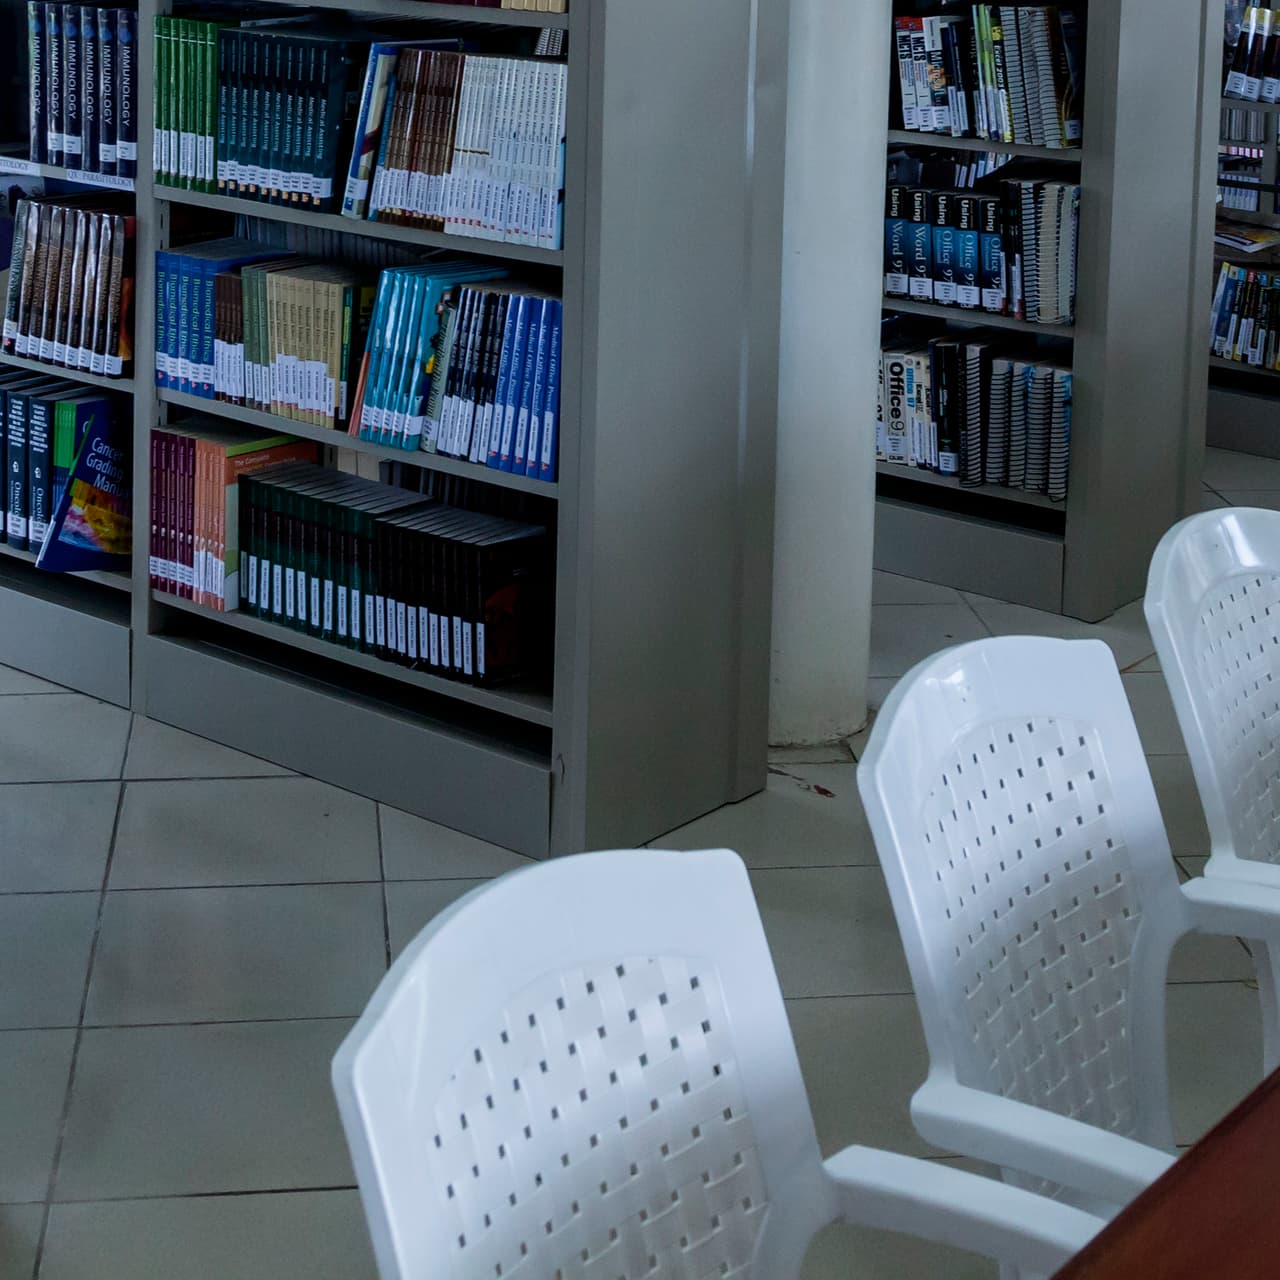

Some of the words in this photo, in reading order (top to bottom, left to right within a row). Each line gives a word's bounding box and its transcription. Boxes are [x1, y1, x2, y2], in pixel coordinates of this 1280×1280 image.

[898, 34, 912, 60] MCTS
[912, 36, 926, 62] MCTS
[33, 36, 41, 114] IMMUNOLOGY
[51, 38, 59, 117] IMMUNOLOGY
[68, 40, 77, 119] IMMUNOLOGY
[86, 42, 94, 121] IMMUNOLOGY
[103, 45, 112, 125] IMMUNOLOGY
[122, 46, 131, 126] IMMUNOLOGY
[891, 188, 900, 216] Using
[913, 193, 922, 221] Using
[937, 196, 947, 225] Using
[960, 200, 969, 229] Using
[986, 202, 996, 231] Using
[892, 222, 904, 255] Word
[915, 226, 927, 260] Word
[942, 230, 953, 265] Office
[964, 234, 975, 269] Office
[990, 237, 1000, 272] Office
[942, 269, 953, 283] 97
[965, 273, 975, 287] 97
[158, 271, 166, 322] Biomedical
[192, 278, 201, 330] Biomedical
[204, 280, 214, 332] Biomedical
[528, 323, 536, 352] Medical
[551, 327, 559, 357] Medical
[890, 362, 904, 419] Office
[91, 437, 124, 458] Cancer
[86, 452, 122, 480] Grading
[93, 473, 128, 497] Manua
